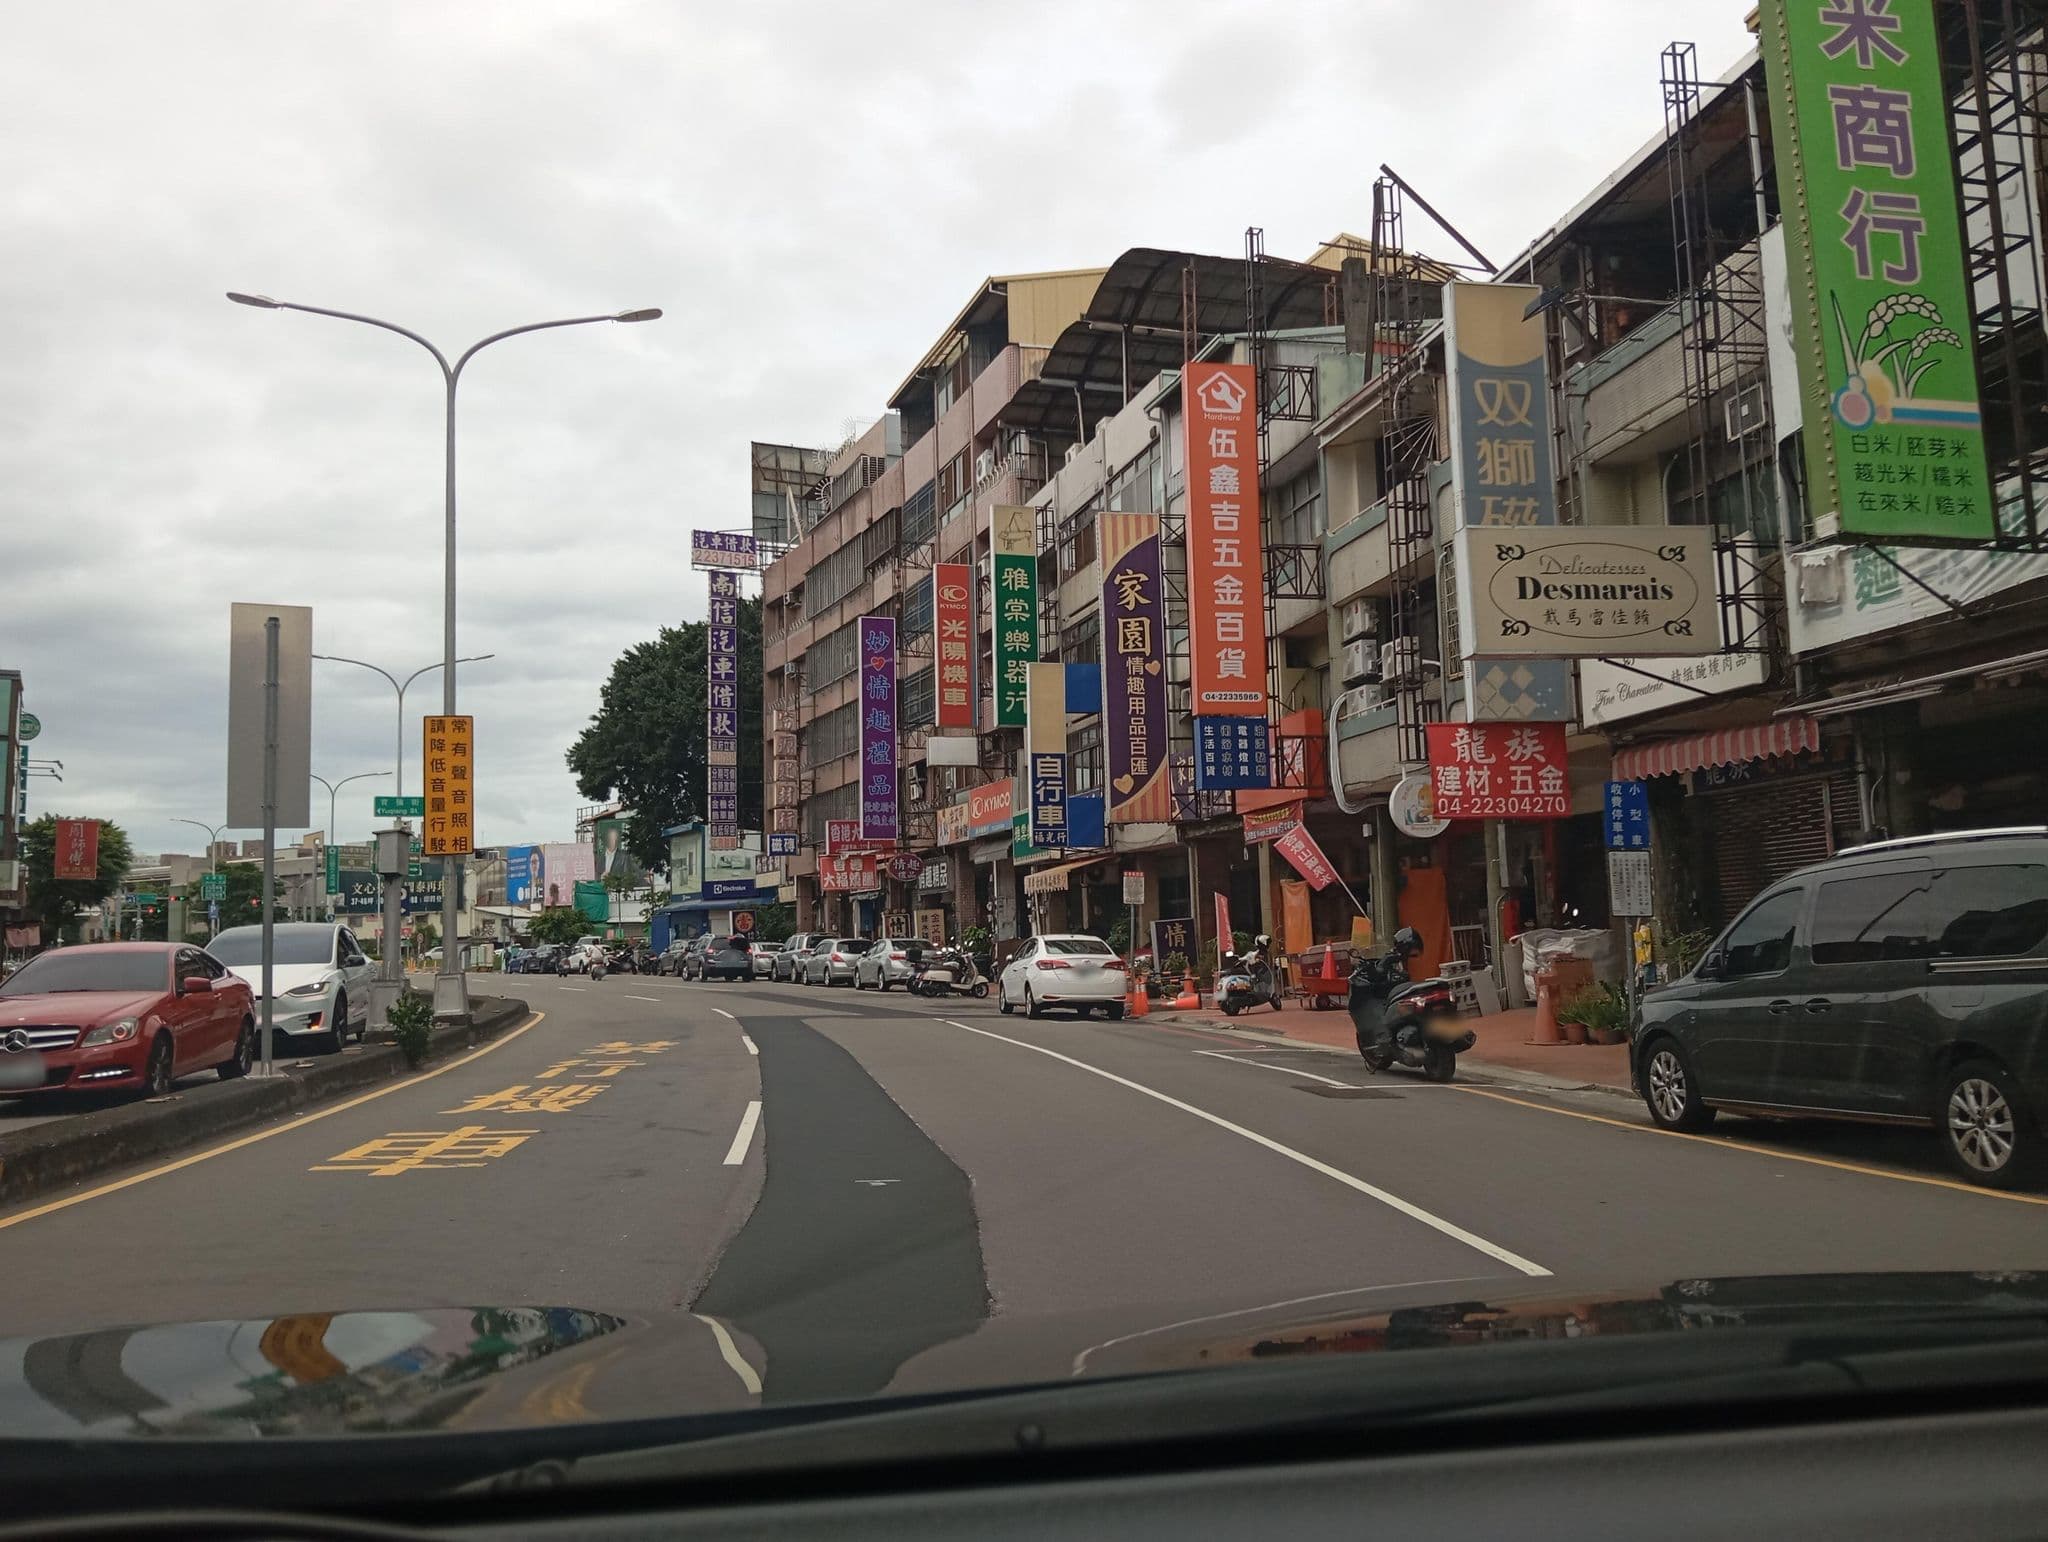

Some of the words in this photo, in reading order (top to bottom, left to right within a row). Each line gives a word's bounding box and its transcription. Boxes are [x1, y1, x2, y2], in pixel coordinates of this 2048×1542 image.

[1203, 412, 1241, 421] Hardware
[694, 533, 755, 553] 汽車借款
[694, 551, 755, 566] 22371515
[1208, 427, 1247, 680] 伍鑫吉五金百貨
[1539, 554, 1647, 576] Delicatesses
[1516, 575, 1674, 601] Desmarais
[712, 574, 735, 736] 南信汽車借款
[942, 619, 968, 706] 光陽機車
[1001, 567, 1031, 714] 雅棠樂器行
[1125, 656, 1149, 776] 情趣用品百匯
[1595, 688, 1616, 707] Fine
[1203, 725, 1216, 777] 生活百貨
[1450, 727, 1547, 765] 龍族
[430, 719, 446, 853] 請降低音量行駛
[451, 719, 468, 852] 常有聲音照相
[983, 792, 1011, 813] KYMCO
[1034, 755, 1064, 827] 自行車
[1437, 797, 1567, 815] 04-22304270
[1610, 784, 1625, 846] 收費停車處
[1629, 784, 1643, 846] 小型車
